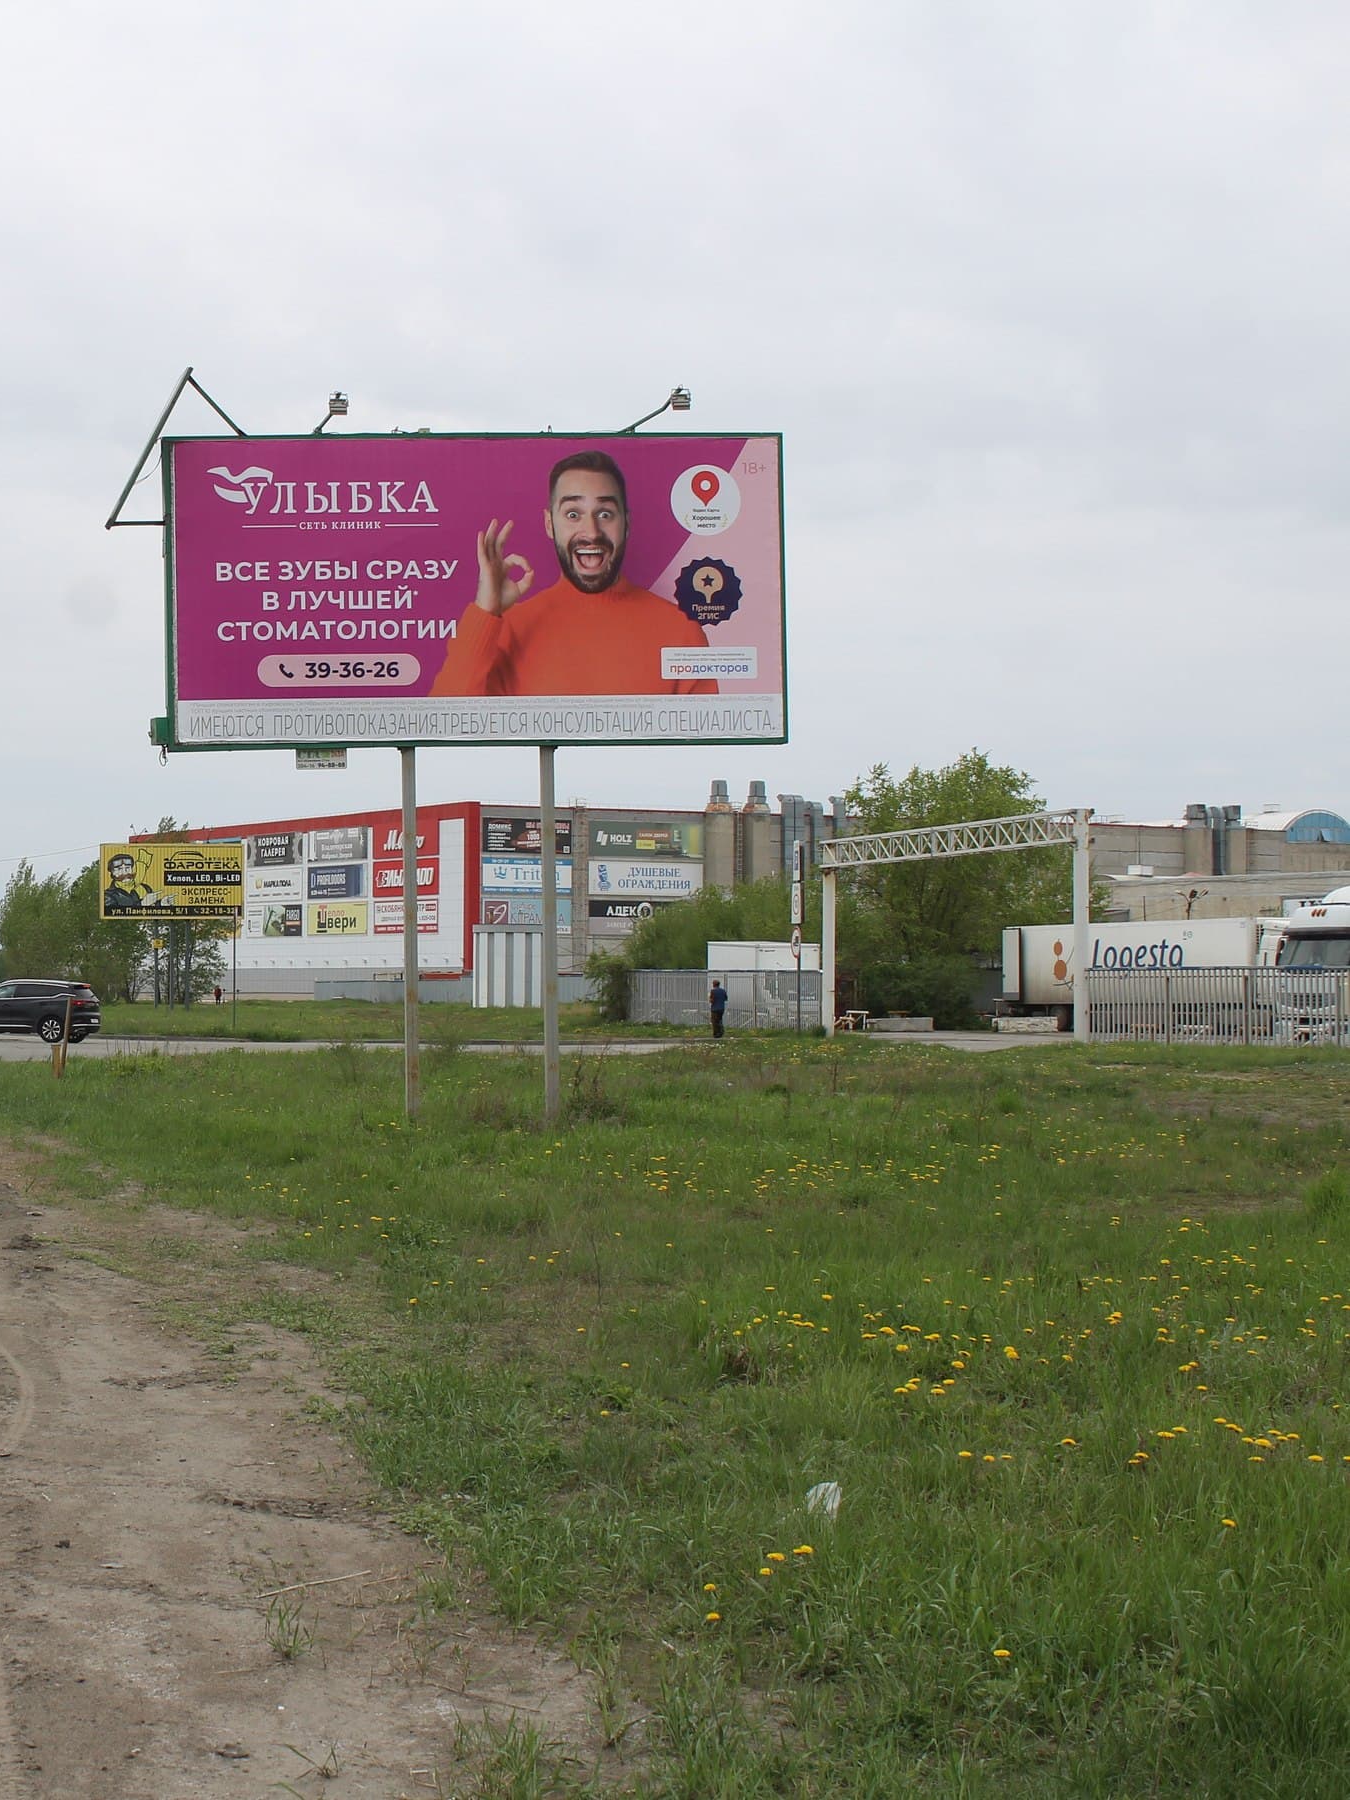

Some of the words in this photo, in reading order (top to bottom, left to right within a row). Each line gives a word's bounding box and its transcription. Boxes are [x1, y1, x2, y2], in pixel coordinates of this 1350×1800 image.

[741, 462, 767, 475] 18+
[240, 480, 439, 515] УЛЫБКА
[299, 521, 327, 531] СЕТЬ
[331, 520, 382, 531] КЛИНИК
[215, 560, 270, 582] ВСЕ
[278, 559, 357, 581] ЗУБЫ
[366, 559, 459, 580] СРАЗУ
[262, 591, 280, 611] В
[692, 604, 725, 613] Премия
[697, 612, 720, 620] 2ГИС
[216, 619, 457, 642] СТОМАТОЛОГИИ
[305, 661, 400, 679] 39-36-26
[670, 664, 749, 675] продокторов
[190, 715, 264, 737] ИМЕЮТСЯ
[534, 711, 653, 735] КОНСУЛЬТАЦИЯ
[658, 710, 776, 734] СПЕЦИАЛИСТА.
[257, 836, 289, 847] КОВРОВАЯ
[610, 834, 633, 843] HOLZ
[260, 847, 286, 858] ГАЛЕРЕЯ
[164, 861, 241, 870] ФАРОТЕКА
[511, 867, 560, 881] Tritn
[627, 867, 682, 878] ДУШЕВЫЕ
[167, 874, 194, 883] Xenon,
[195, 874, 214, 883] LED,
[215, 874, 241, 882] Bi-LED
[617, 879, 691, 890] ОГРАЖДЕНИЯ
[181, 887, 232, 896] ЭКСПРЕСС-
[188, 896, 226, 905] ЗАМЕНА
[111, 908, 124, 916] ул.
